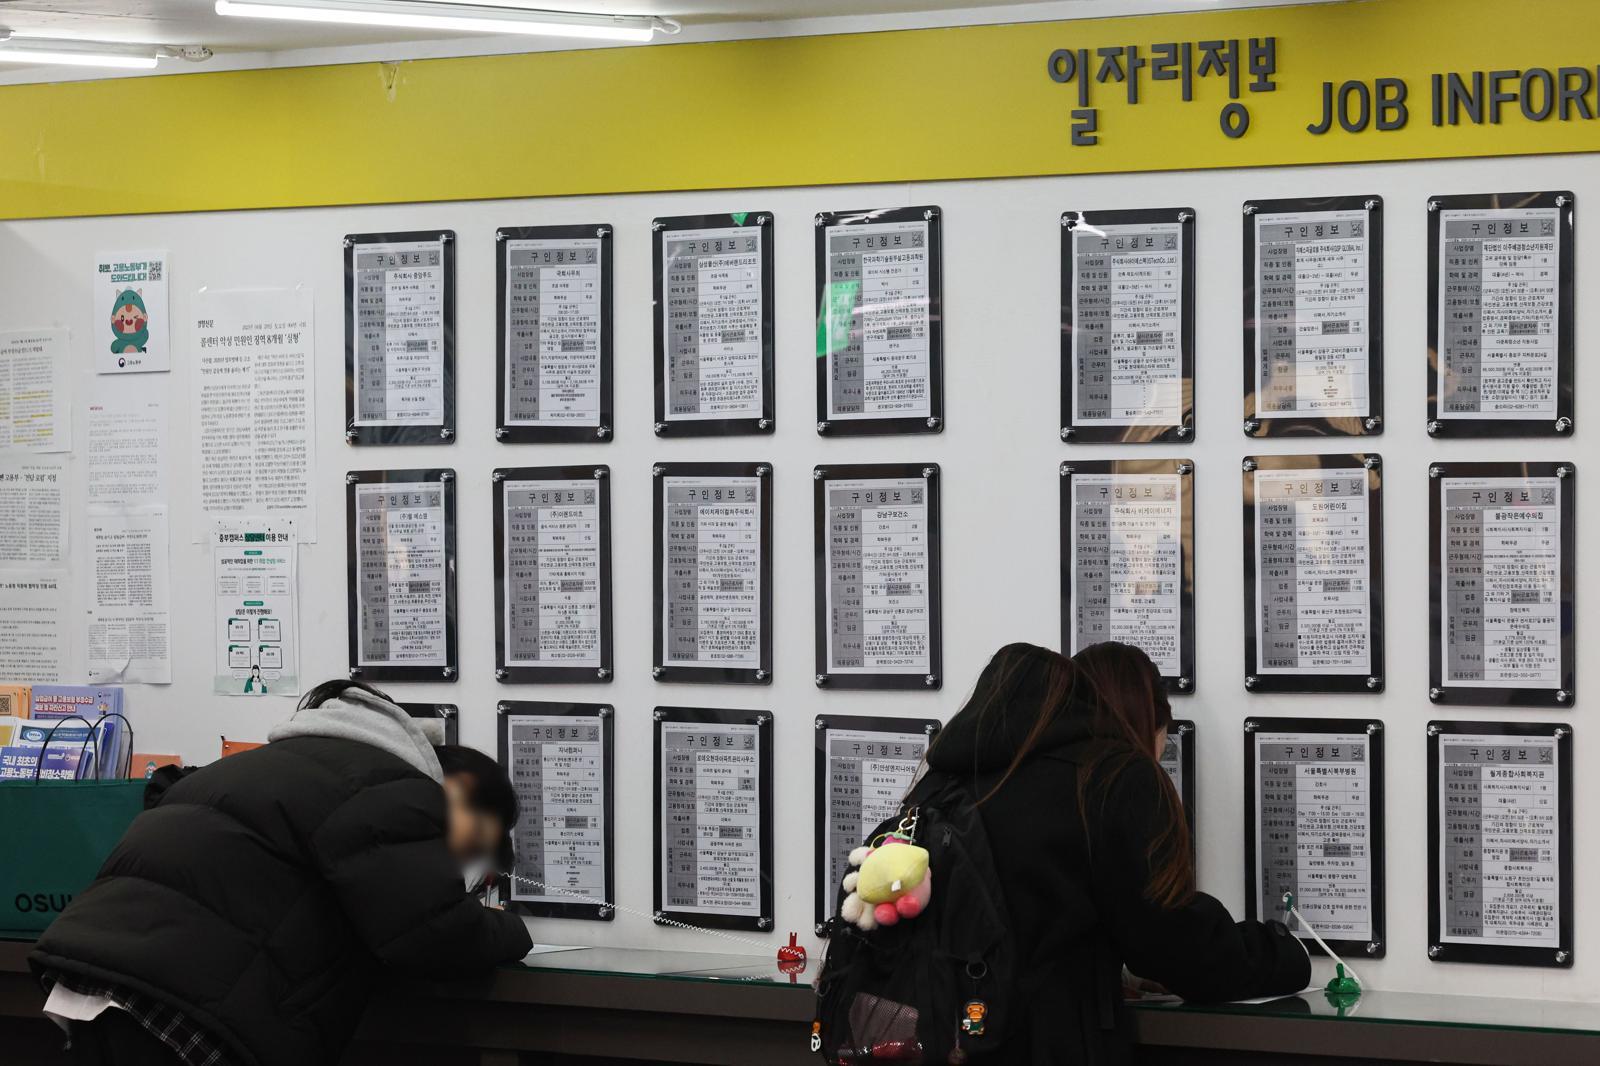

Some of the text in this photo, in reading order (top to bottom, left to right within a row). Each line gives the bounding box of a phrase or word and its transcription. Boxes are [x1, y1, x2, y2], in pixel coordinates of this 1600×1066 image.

[1048, 37, 1276, 146] 일자리정보
[1307, 65, 1600, 135] JOB INFOR
[1503, 243, 1553, 251] 이주배경청소년지원재단
[220, 336, 232, 347] 악성
[234, 335, 252, 346] 민원인
[254, 335, 265, 345] 징역
[1312, 503, 1347, 511] 도원어린이집
[1496, 512, 1543, 520] 불광작은예수의집
[219, 534, 243, 542] 중부캠퍼스
[266, 533, 276, 542] 이용
[278, 533, 288, 541] 안내
[3, 756, 37, 766] 국내 최초의
[0, 768, 33, 778] 고용노동부
[1304, 767, 1356, 775] 서울특별시북부병원
[1490, 770, 1544, 779] 월계종합사회복지관
